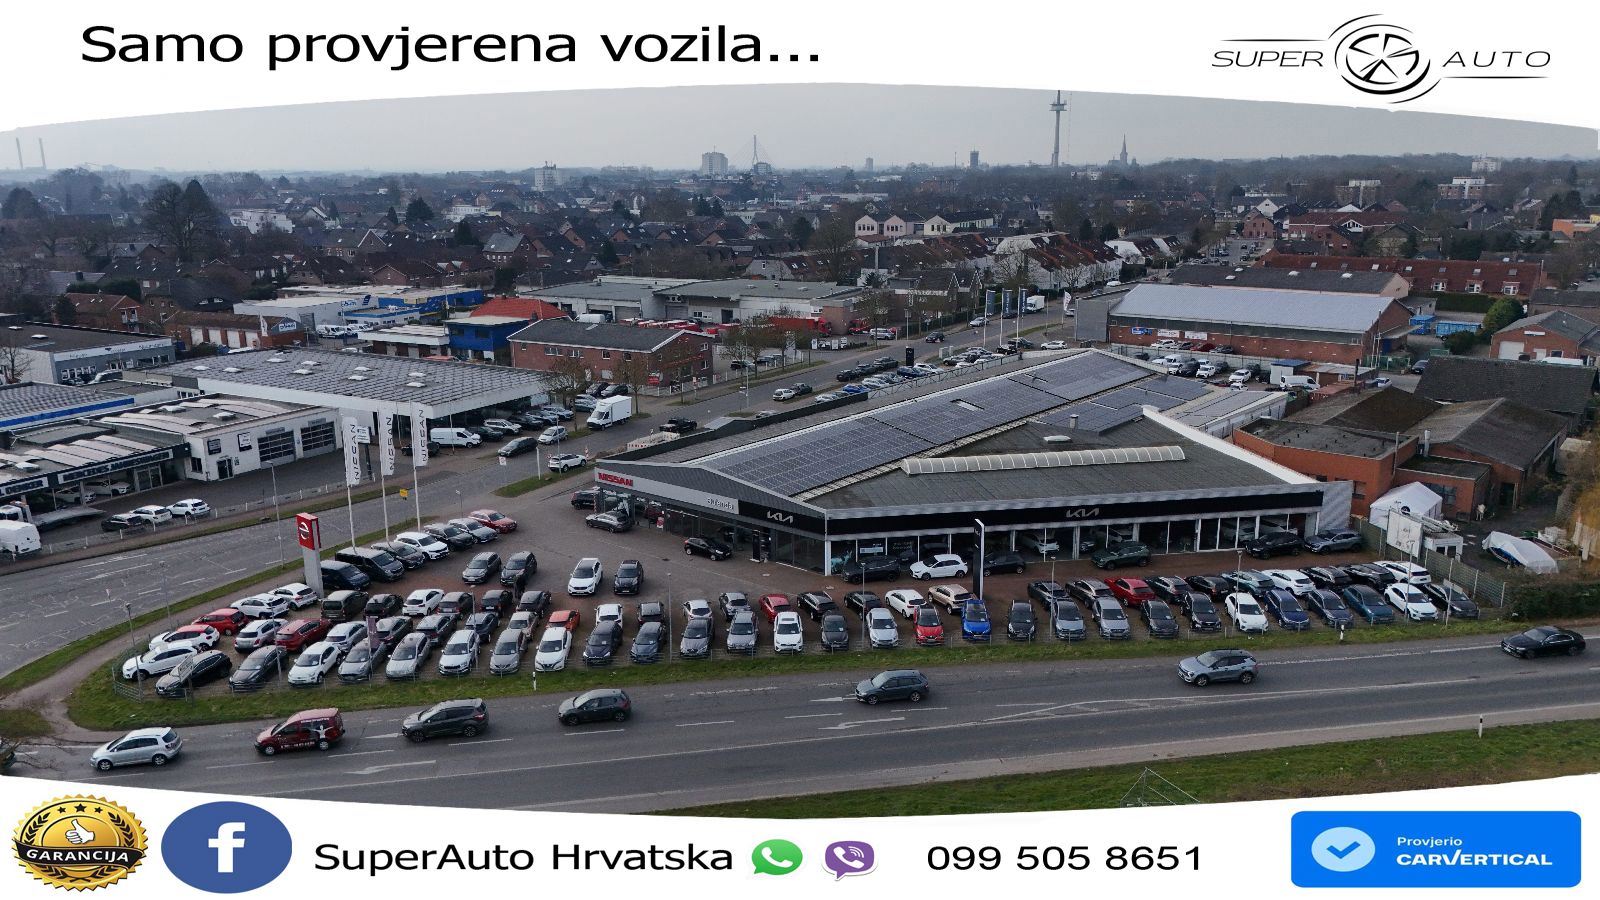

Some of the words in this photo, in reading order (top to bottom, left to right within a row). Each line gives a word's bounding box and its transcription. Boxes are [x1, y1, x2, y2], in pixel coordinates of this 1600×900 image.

[598, 472, 634, 487] NISSAN
[766, 510, 794, 525] KIA
[1066, 507, 1100, 518] KIA
